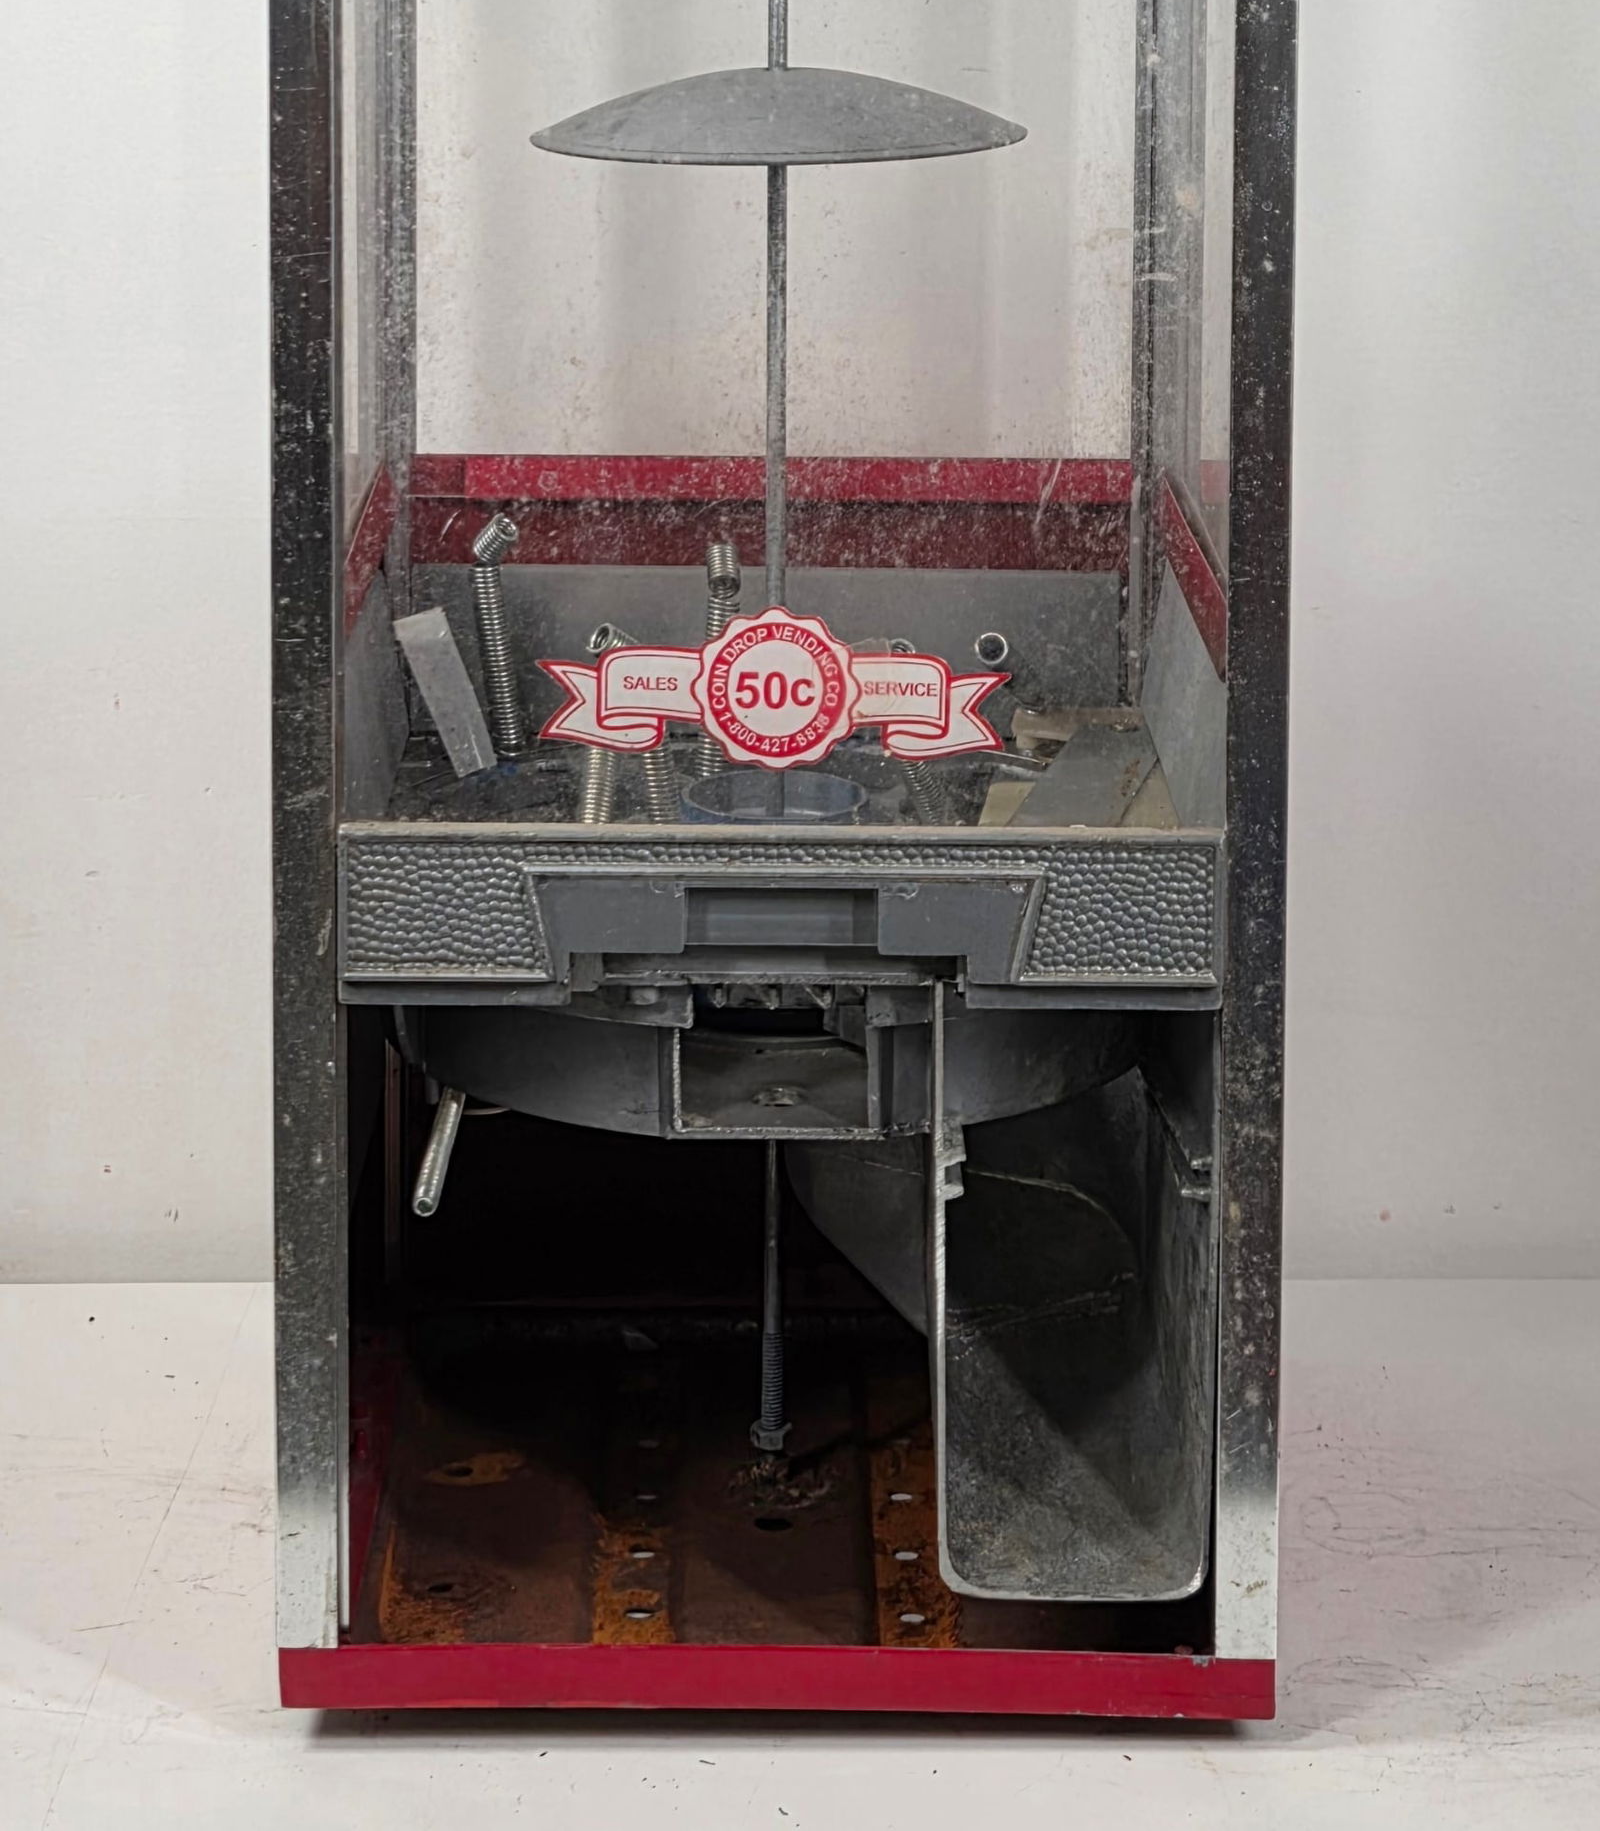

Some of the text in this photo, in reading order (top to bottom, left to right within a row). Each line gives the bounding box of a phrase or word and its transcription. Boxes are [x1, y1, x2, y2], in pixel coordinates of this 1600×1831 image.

[711, 625, 841, 710] COIN DROP VENDING CO
[623, 675, 678, 692] SALES
[734, 670, 815, 710] 50c
[863, 679, 938, 698] SERVICE
